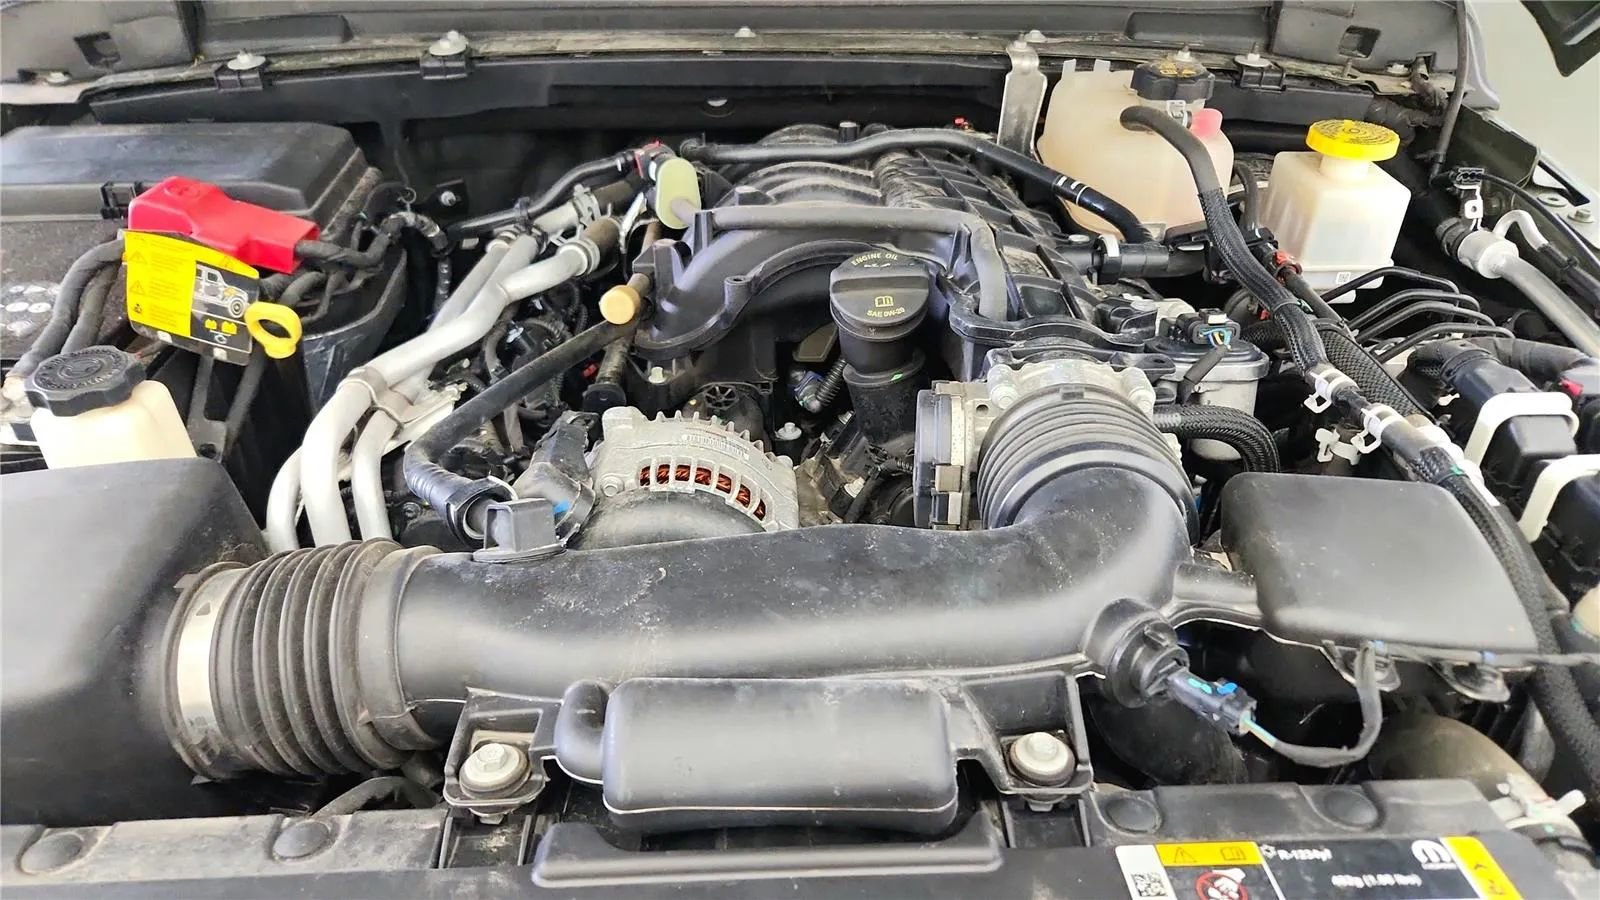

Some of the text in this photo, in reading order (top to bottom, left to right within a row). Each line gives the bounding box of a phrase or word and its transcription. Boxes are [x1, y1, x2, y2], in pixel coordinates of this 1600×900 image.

[851, 252, 899, 266] ENGINE OIL
[867, 306, 905, 318] SAE 0W-20
